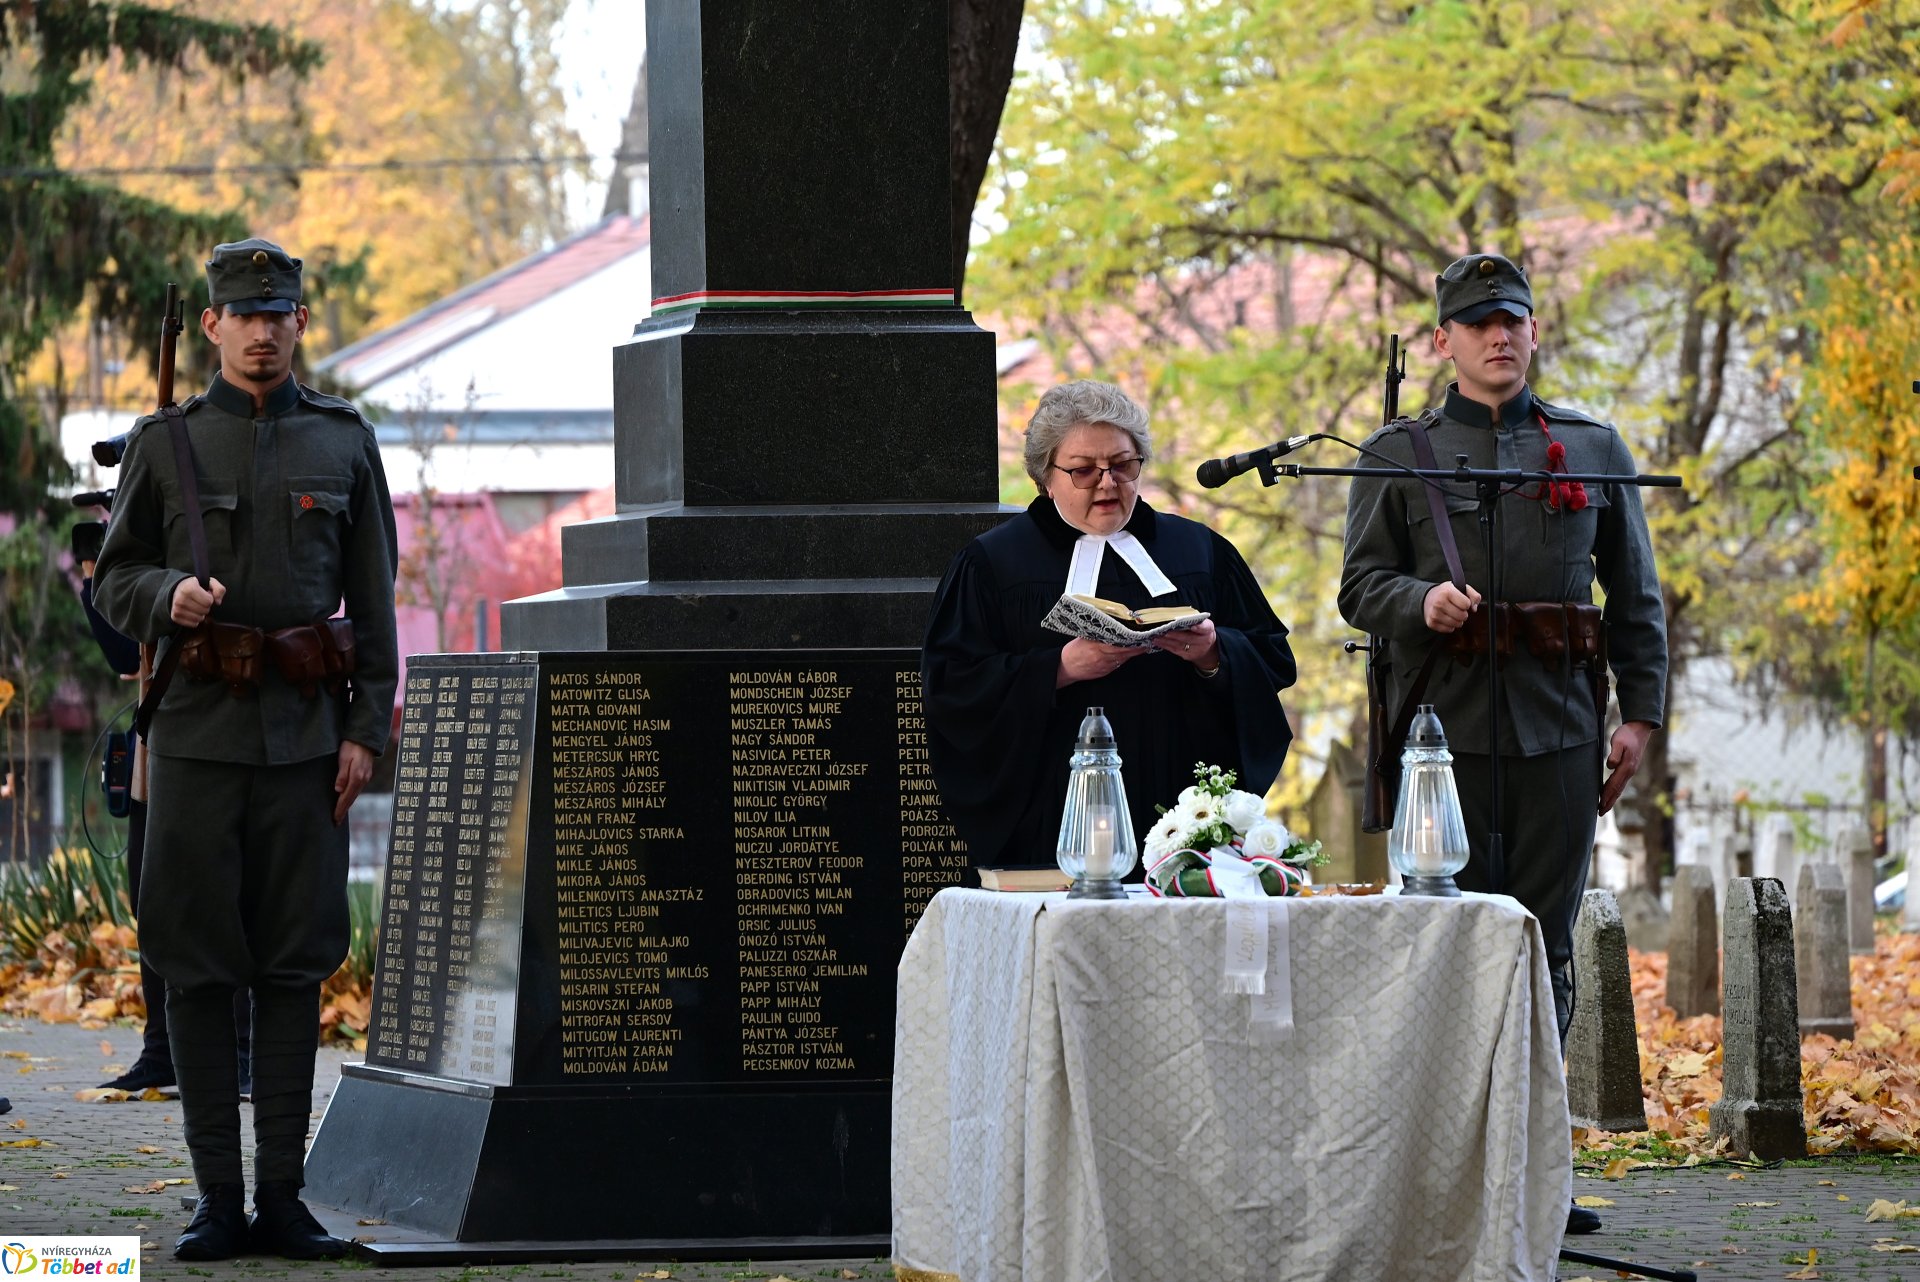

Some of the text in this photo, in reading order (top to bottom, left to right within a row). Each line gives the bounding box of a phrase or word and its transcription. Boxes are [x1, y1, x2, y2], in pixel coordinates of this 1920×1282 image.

[549, 669, 642, 685] MATOS SÁNDOR
[729, 668, 838, 684] MOLDOVÁN GÁBOR
[550, 688, 651, 701] MATOWITZ GLISA
[729, 683, 853, 699] MONDSCHEIN JÓZSEF
[551, 703, 641, 716] MATTA GIOVANI
[730, 702, 842, 715] MUREKOVICS MURE
[551, 719, 671, 732] MECHANOVIC HASIM
[731, 714, 832, 730] MUSZLER TAMÁS
[551, 731, 652, 747] MENGYEL JÁNOS
[731, 730, 815, 745] NAGY SÁNDOR
[552, 750, 660, 763] METERCSUK HRYC
[732, 748, 831, 761] NASIVICA PETER
[553, 762, 660, 778] MÉSZÁROS JÁNOS
[732, 760, 869, 777] NAZDRAVECZKI JÓZSEF
[553, 777, 667, 794] MÉSZÁROS JÓZSEF
[733, 779, 851, 792] NIKITISIN VLADIMIR
[554, 792, 667, 809] MÉSZÁROS MIHÁLY
[733, 791, 828, 807] NIKOLIC GYÖRGY
[554, 812, 636, 825] MICAN FRANZ
[733, 810, 797, 823] NILOV ILIA
[900, 806, 939, 821] POÁZS
[555, 827, 685, 840] MIHAJLOVICS STARKA
[734, 826, 830, 838] NOSAROK LITKIN
[555, 840, 629, 856] MIKE JÁNOS
[735, 838, 840, 854] NUCZU JORDÁTYE
[901, 837, 945, 852] POLYÁK
[556, 855, 637, 871] MIKLE JÁNOS
[735, 856, 864, 869] NYESZTEROV FEODOR
[902, 855, 933, 867] POPA
[556, 870, 647, 887] MIKORA JÁNOS
[736, 869, 841, 885] OBERDING ISTVÁN
[903, 867, 962, 883] POPESZKÓ
[557, 885, 704, 902] MILENKOVITS ANASZTÁZ
[736, 887, 852, 900] OBRADOVICS MILAN
[903, 886, 935, 898] POPP
[557, 905, 659, 918] MILETICS LJUBIN
[737, 903, 843, 916] OCHRIMENKO IVAN
[558, 921, 645, 933] MILITICS PERO
[737, 919, 817, 931] ORSIC JULIUS
[558, 935, 689, 949] MILIVAJEVIC MILAJKO
[738, 931, 826, 946] ÓNOZÓ ISTVÁN
[559, 951, 668, 964] MILOJEVICS TOMO
[739, 946, 837, 962] PALUZZI OSZKÁR
[559, 962, 709, 980] MILOSSAVLEVITS MIKLÓS
[739, 964, 868, 977] PANESERKO JEMILIAN
[560, 982, 660, 995] MISARIN STEFAN
[740, 977, 819, 993] PAPP ISTVÁN
[561, 998, 673, 1011] MISKOVSZKI JAKOB
[740, 993, 822, 1008] PAPP MIHÁLY
[561, 1013, 672, 1027] MITROFAN SERSOV
[741, 1011, 821, 1024] PAULIN GUIDO
[562, 1029, 682, 1042] MITUGOW LAURENTI
[742, 1023, 839, 1039] PÁNTYA JÓZSEF
[562, 1041, 673, 1058] MITYITJÁN ZARÁN
[742, 1039, 843, 1055] PÁSZTOR ISTVÁN
[563, 1056, 668, 1073] MOLDOVÁN ÁDÁM
[743, 1057, 855, 1071] PECSENKOV KOZMA
